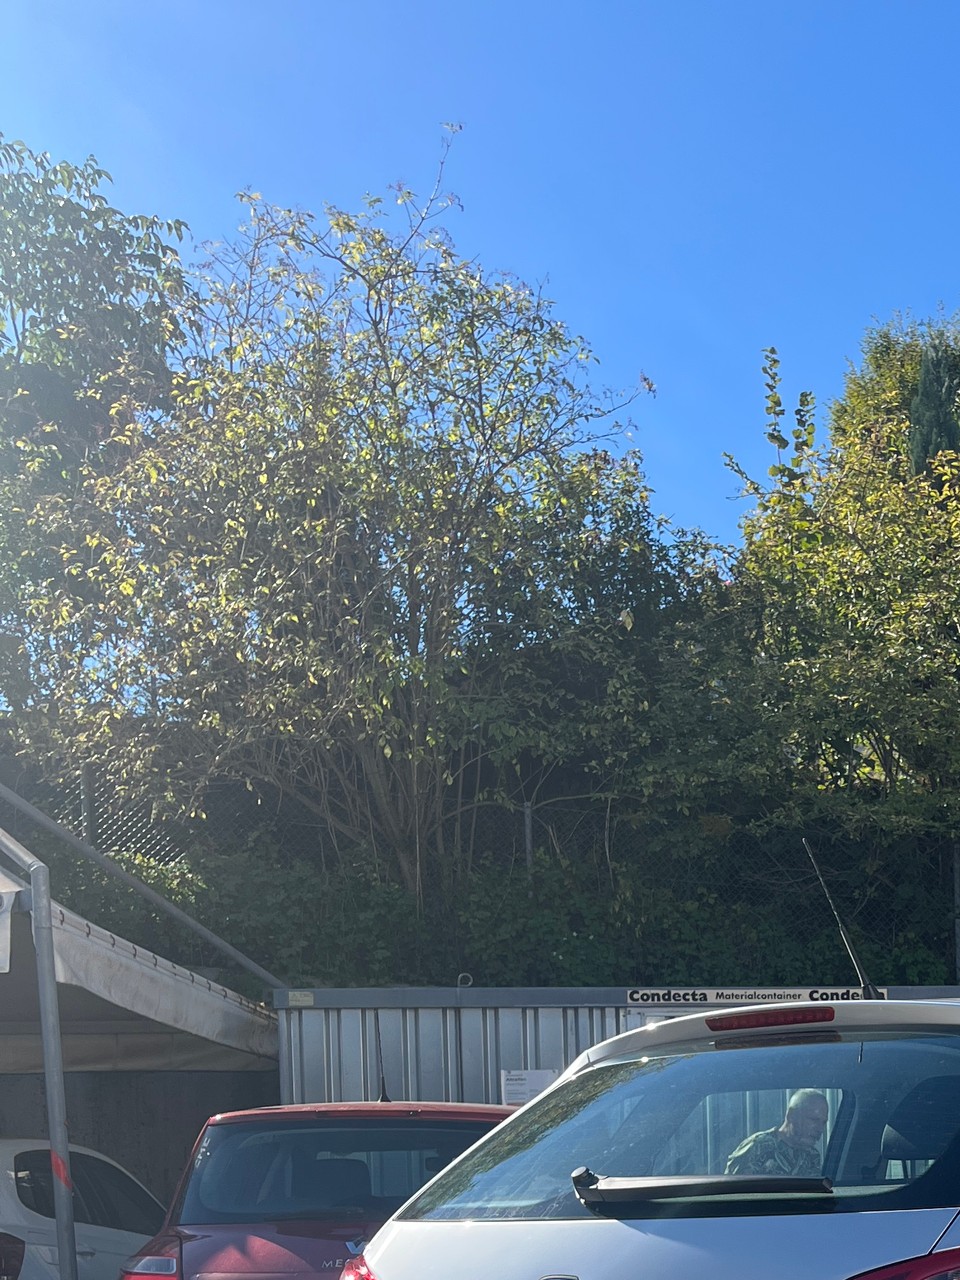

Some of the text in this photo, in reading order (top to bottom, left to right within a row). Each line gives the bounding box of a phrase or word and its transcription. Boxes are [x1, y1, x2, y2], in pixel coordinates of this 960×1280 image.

[629, 989, 885, 1002] Condecta Materialcontainer Conde
[321, 1259, 350, 1268] ME
